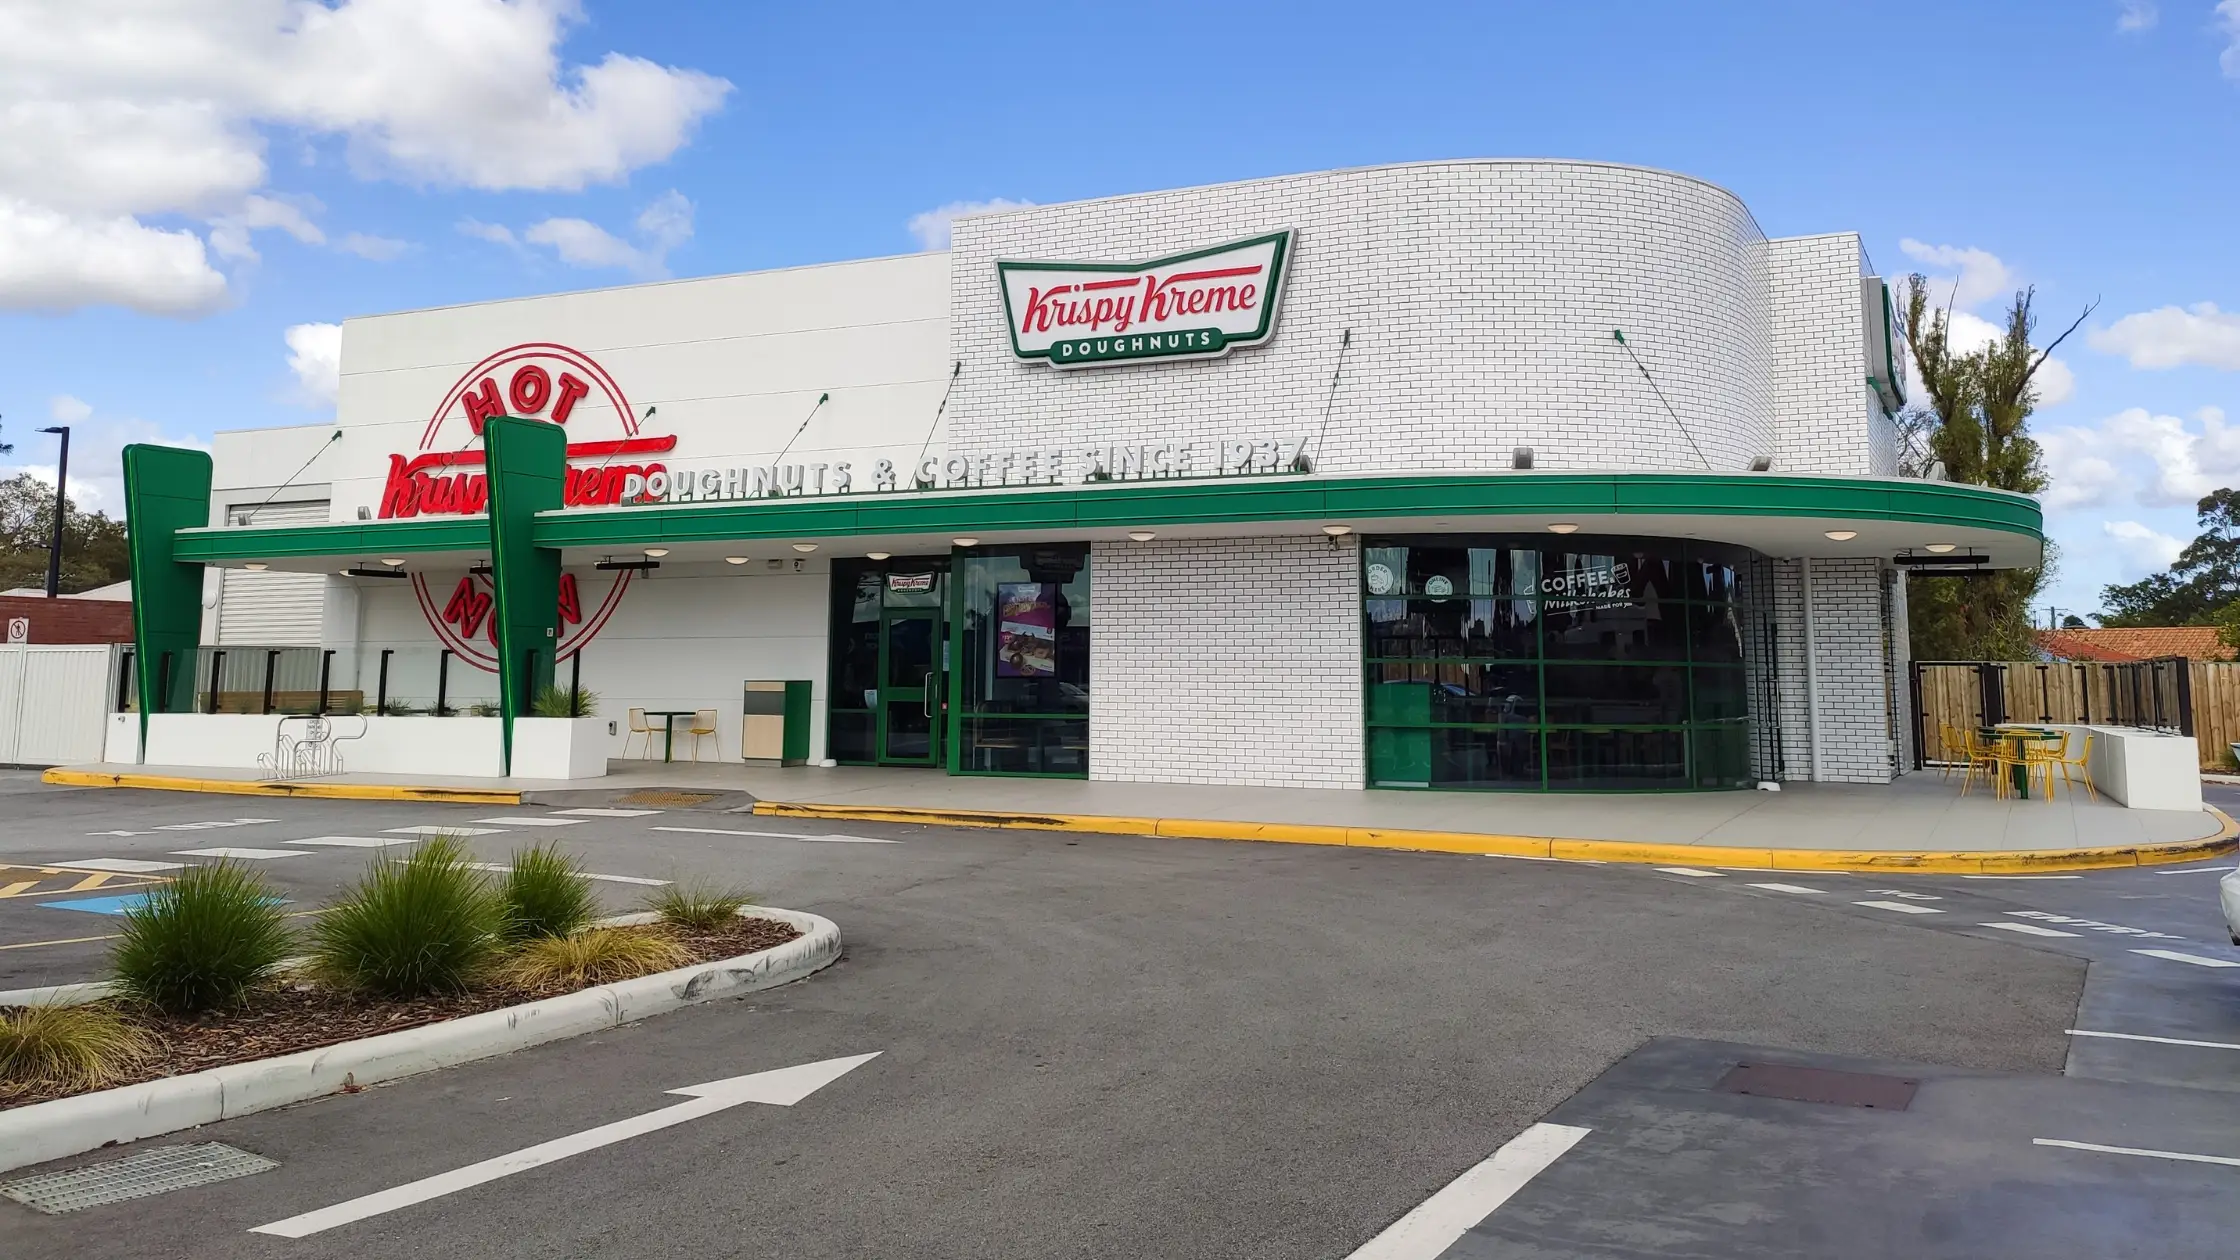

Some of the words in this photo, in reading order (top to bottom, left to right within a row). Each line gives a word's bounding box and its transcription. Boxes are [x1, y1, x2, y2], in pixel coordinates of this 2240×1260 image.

[1022, 276, 1141, 333] Krispy
[1139, 264, 1263, 322] Kreme
[1062, 331, 1210, 357] DOUGHNUTS
[462, 365, 589, 436] HOT
[624, 461, 852, 498] DOUGHNUTS
[871, 458, 896, 485] &
[916, 449, 1063, 483] COFFEE
[1080, 442, 1192, 477] SINCE
[1214, 436, 1308, 470] 1937
[1541, 570, 1609, 592] COFFEE
[1865, 889, 1943, 900] NO
[2002, 911, 2187, 939] ENTRY
